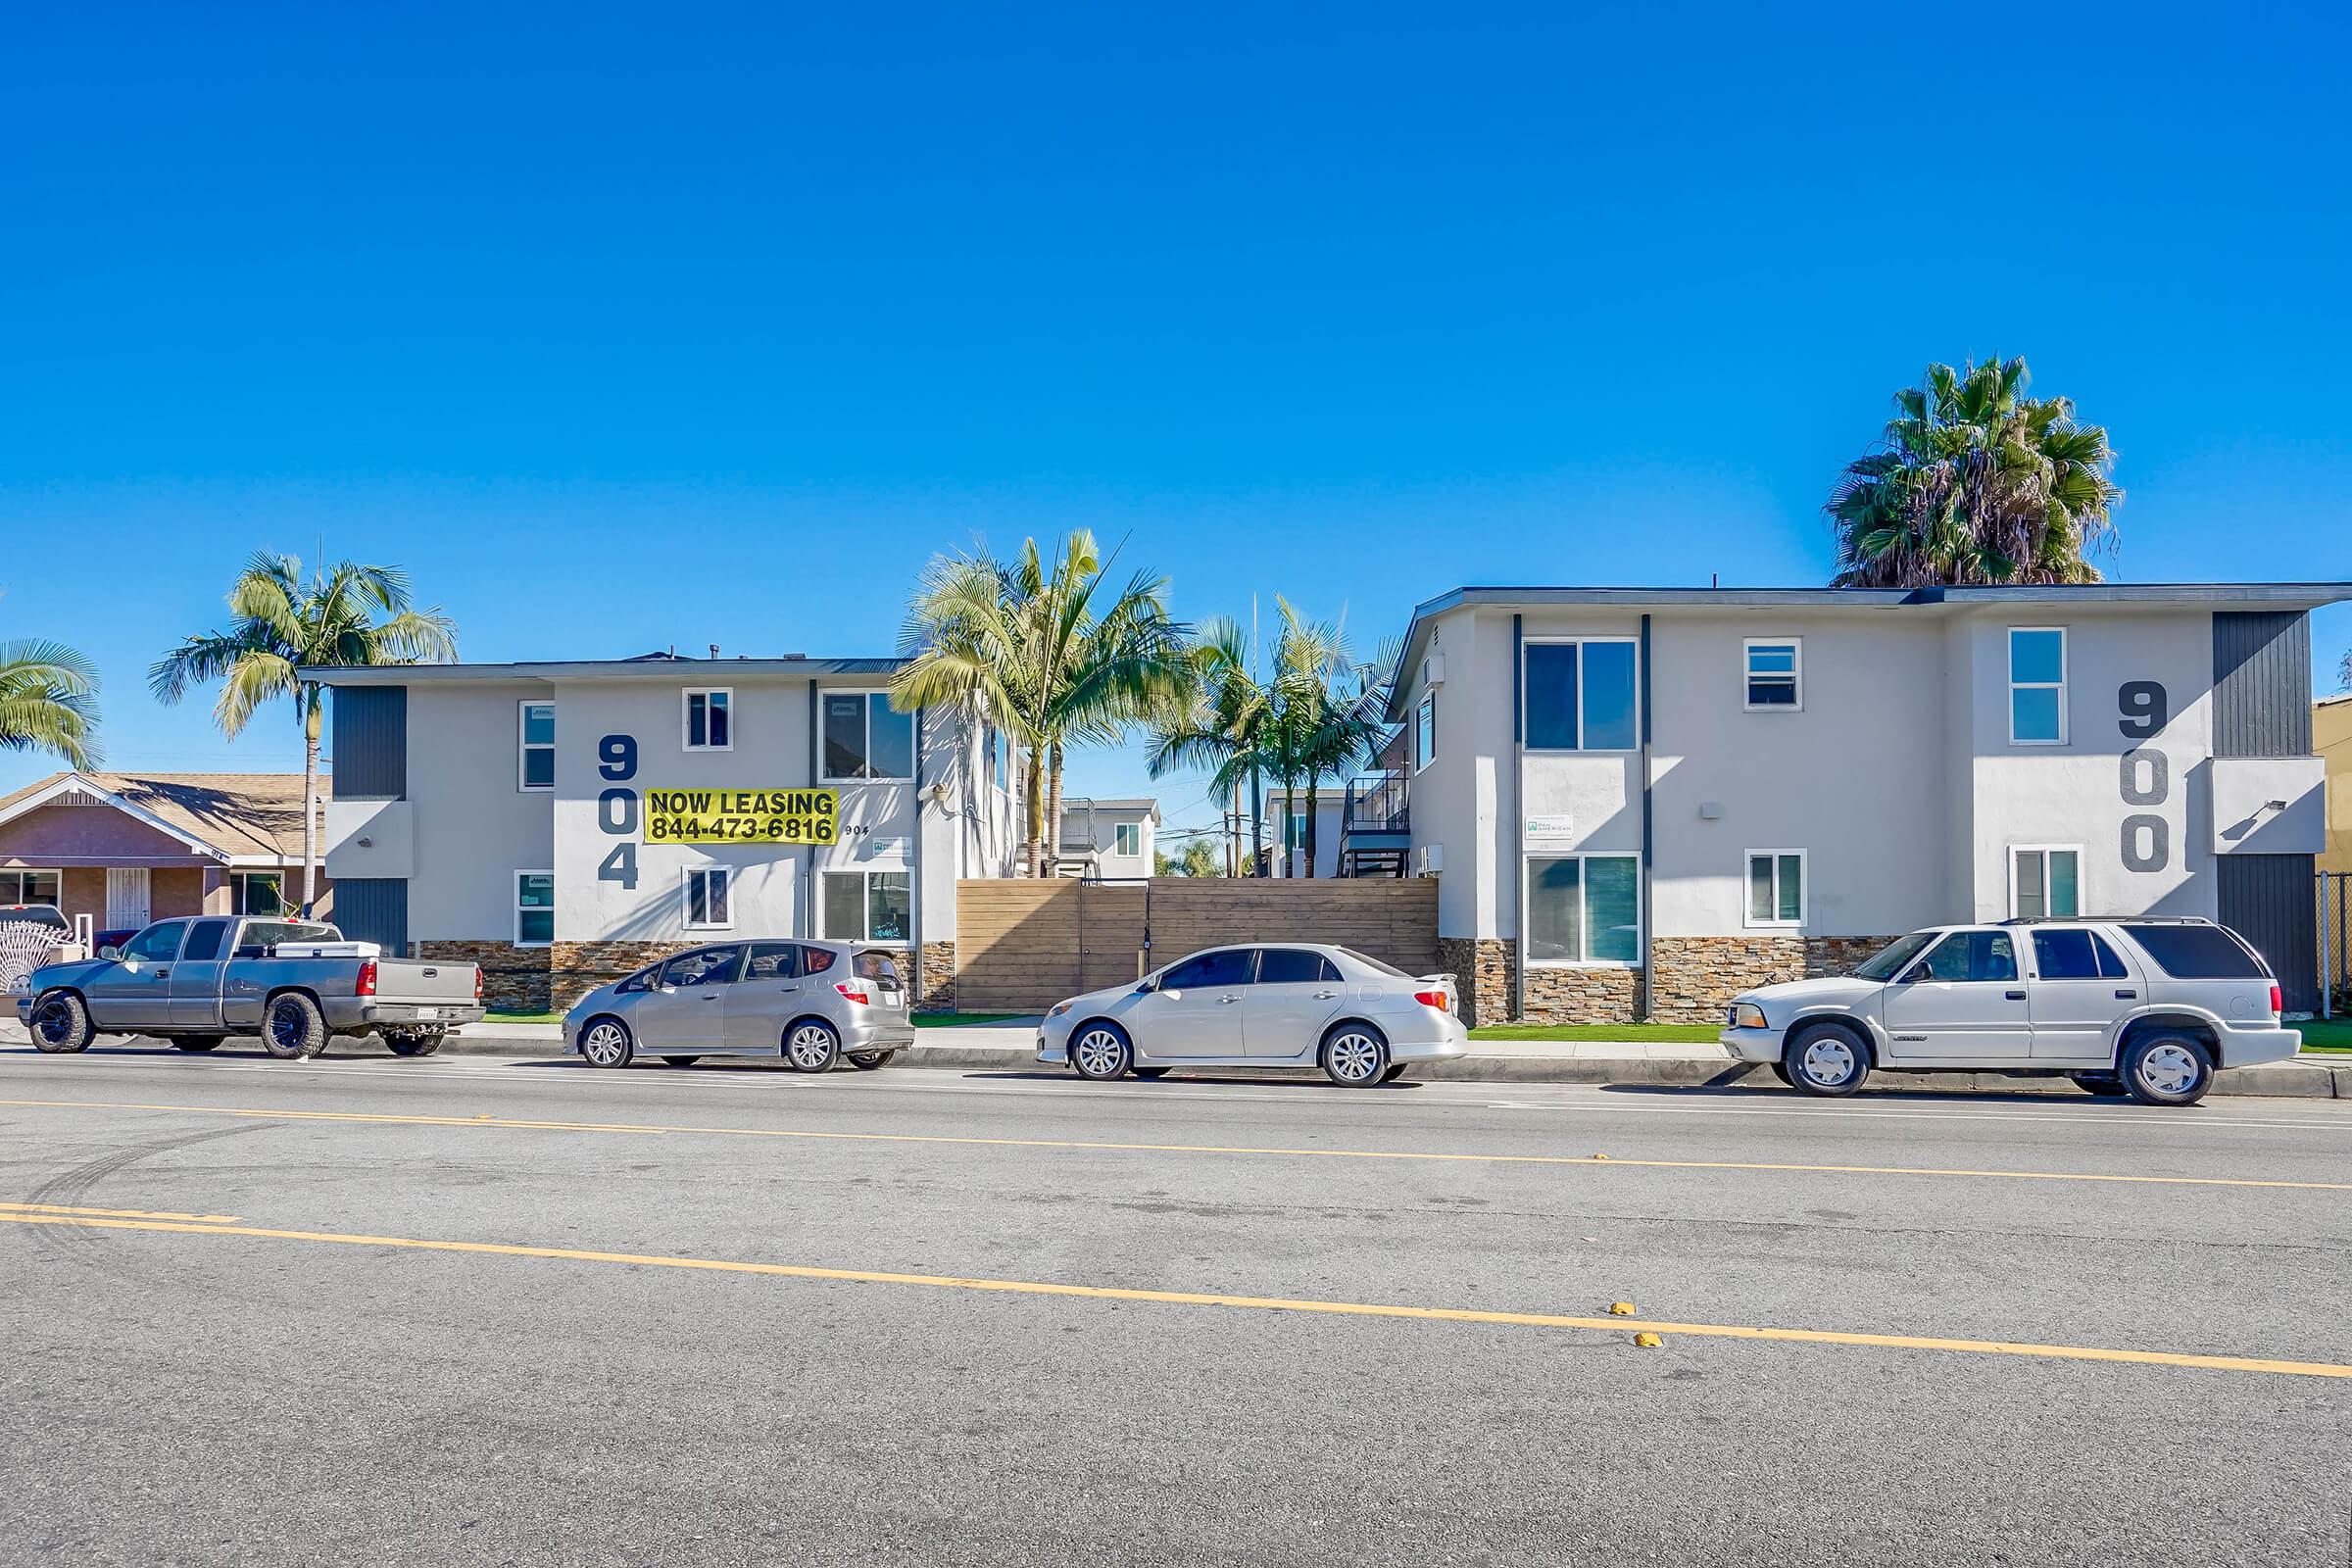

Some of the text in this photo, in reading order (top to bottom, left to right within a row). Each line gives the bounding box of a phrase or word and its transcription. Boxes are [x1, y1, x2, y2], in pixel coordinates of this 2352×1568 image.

[2119, 681, 2169, 872] 900
[598, 735, 638, 889] 904
[651, 793, 833, 814] NOW LEASING
[651, 817, 832, 840] 844-473-6816
[845, 825, 869, 835] 904
